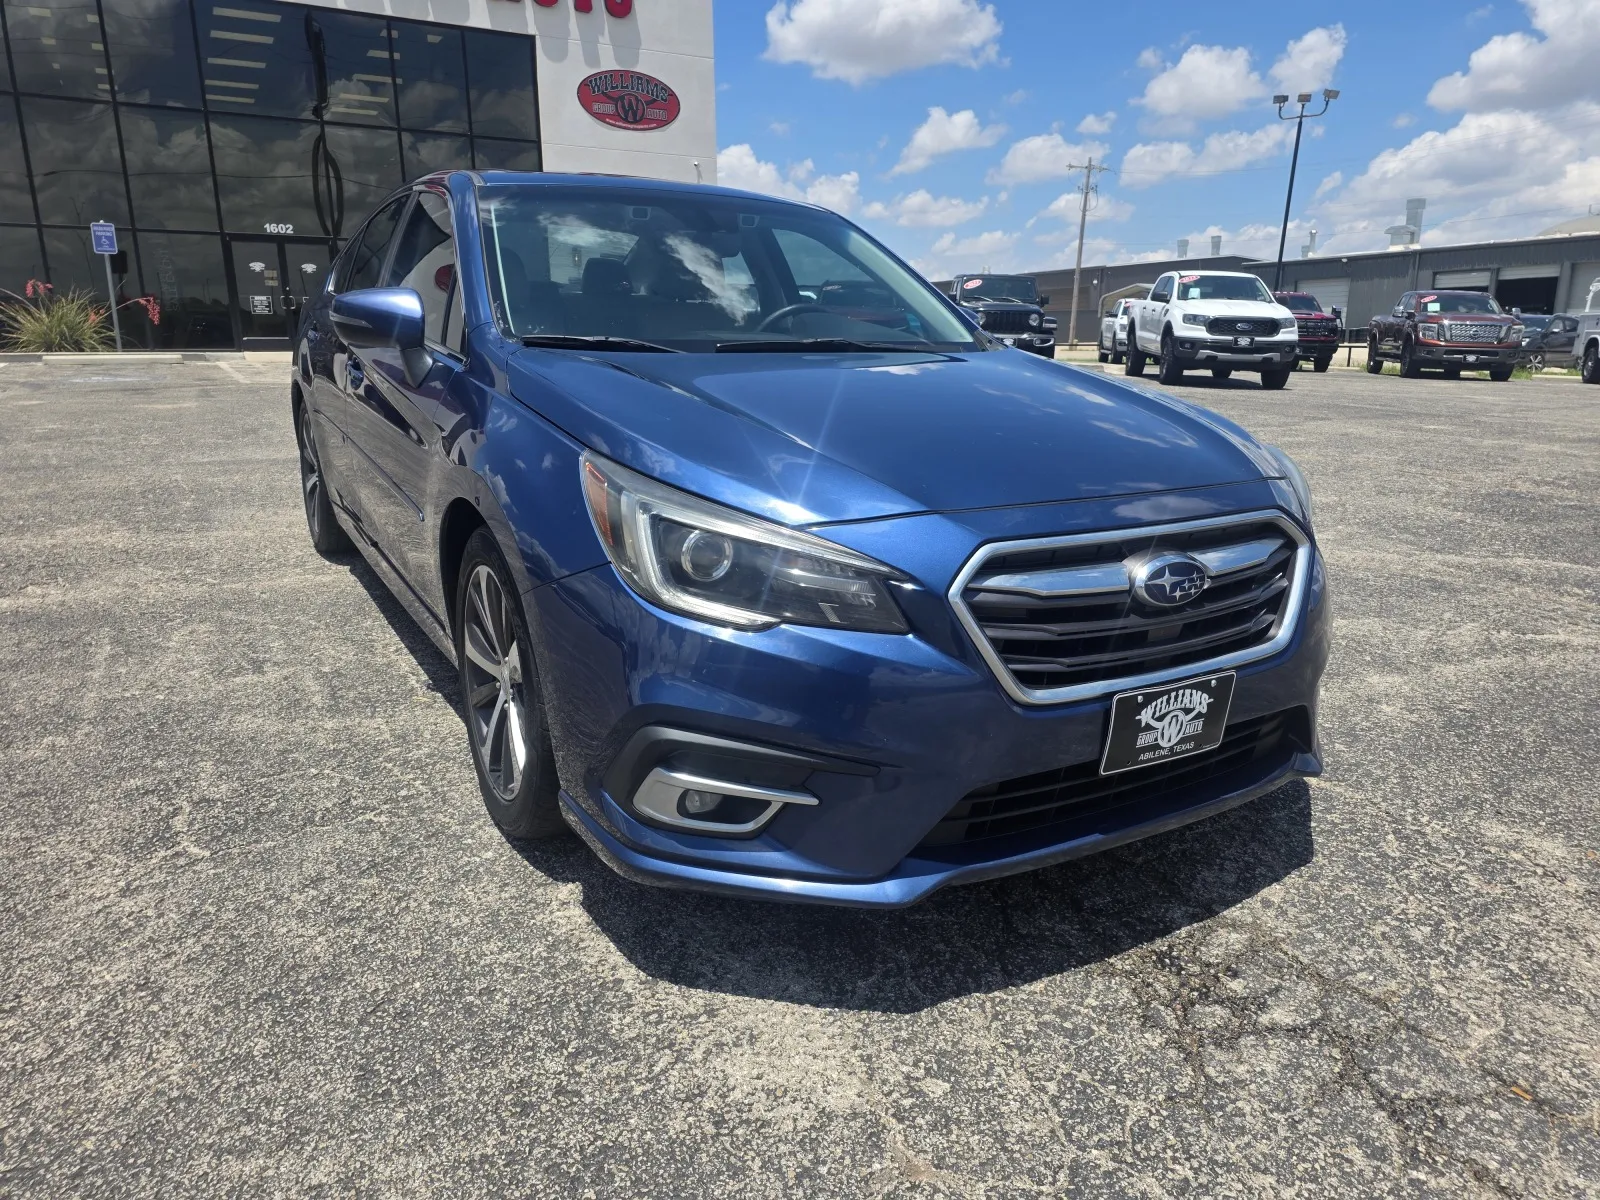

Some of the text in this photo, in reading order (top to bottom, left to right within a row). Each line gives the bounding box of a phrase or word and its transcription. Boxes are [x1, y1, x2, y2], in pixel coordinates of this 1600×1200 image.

[588, 73, 668, 103] WILLIAMS
[592, 102, 616, 114] GROUP
[647, 109, 668, 120] AUTO
[264, 223, 294, 234] 1602
[1141, 689, 1209, 727] WILLIAMS
[1136, 732, 1159, 746] GROUP
[1184, 720, 1203, 735] AUTO
[1138, 741, 1195, 761] ABILENE, TEXAS
